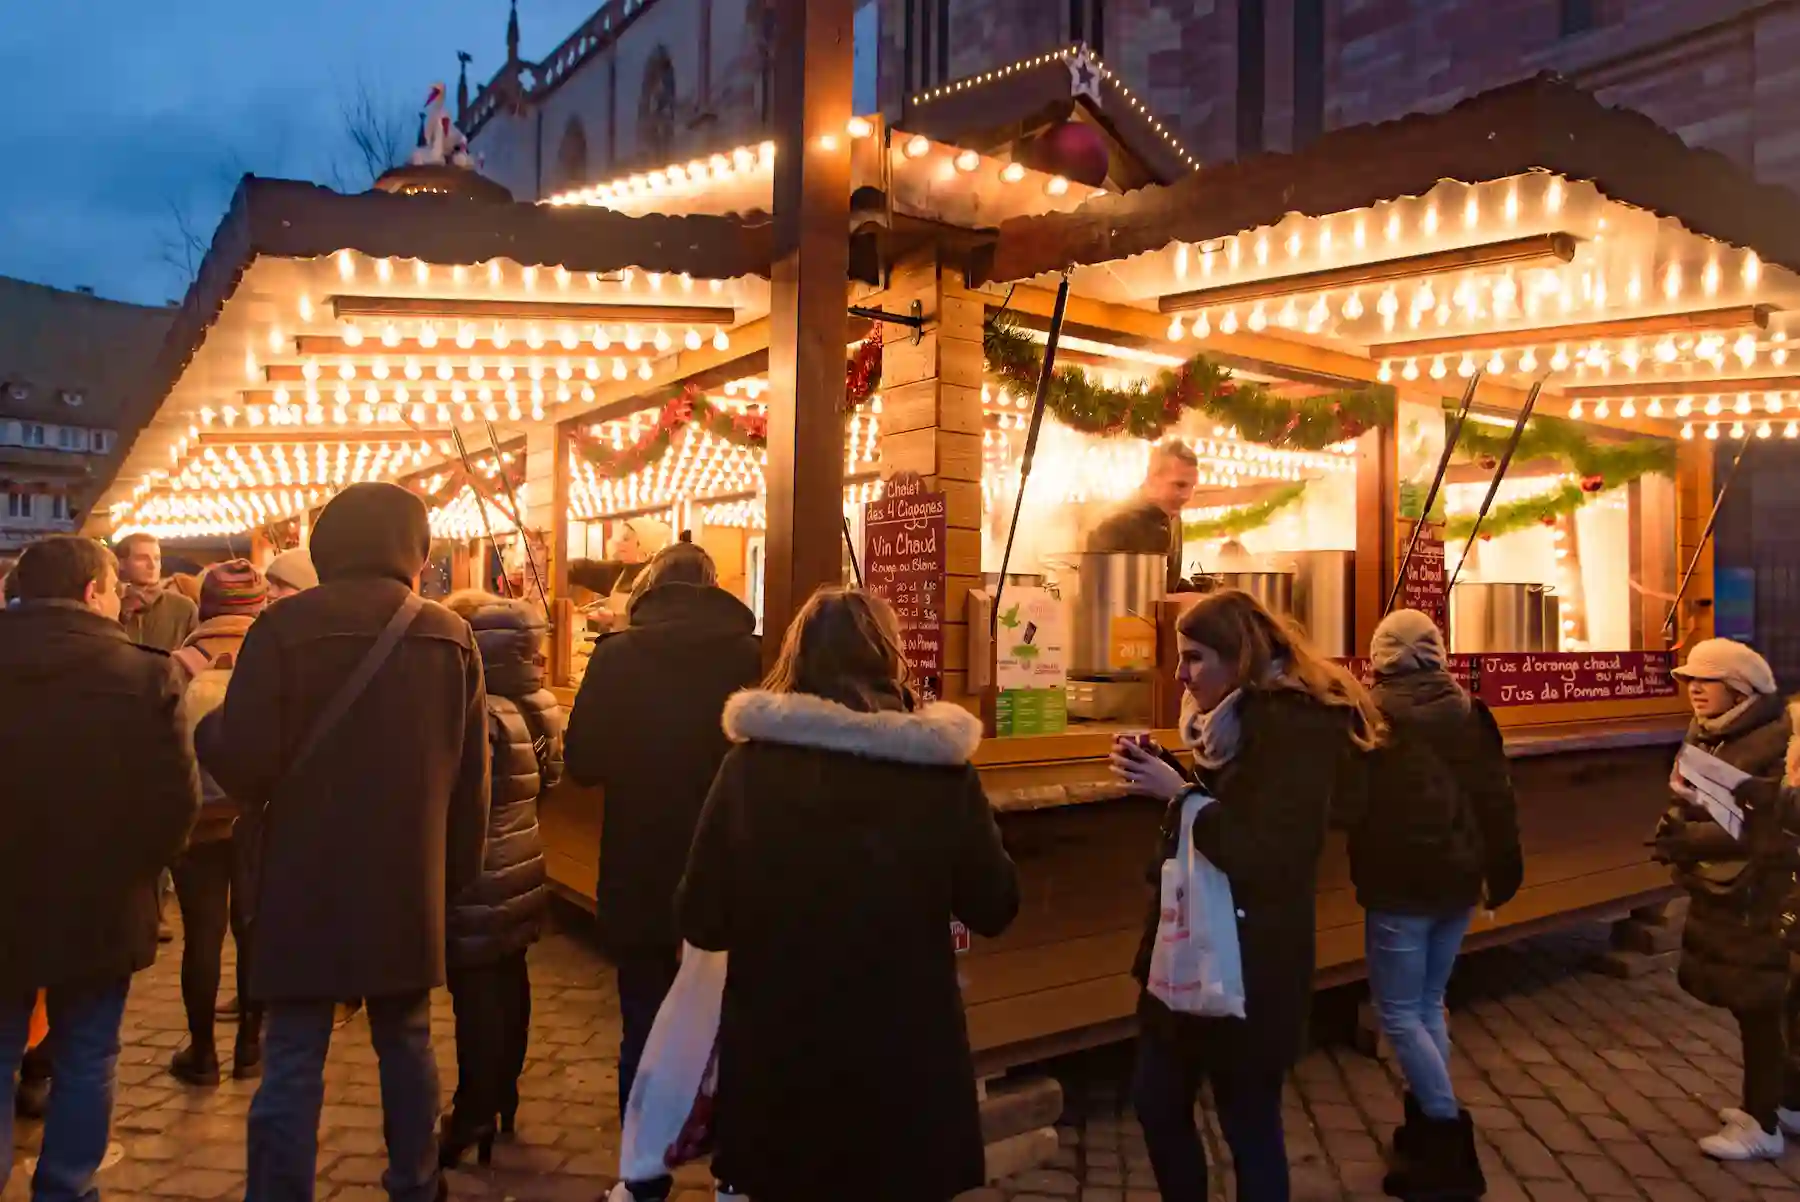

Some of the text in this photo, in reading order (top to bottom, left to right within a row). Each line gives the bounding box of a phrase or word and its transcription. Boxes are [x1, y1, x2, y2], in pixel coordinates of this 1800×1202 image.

[887, 477, 920, 498] Chalet
[867, 499, 944, 531] des 4 Cigognes
[872, 527, 937, 557] Vin Chaud
[871, 557, 938, 583] Rouge ou Blanc
[896, 594, 909, 605] 25
[1486, 658, 1517, 673] Jus
[1522, 655, 1580, 681] d'orange
[1583, 654, 1620, 670] chaud
[1596, 672, 1611, 682] au
[1615, 665, 1637, 681] miel
[1501, 684, 1535, 701] Jus
[1540, 682, 1559, 700] de
[1563, 682, 1611, 699] Pomme
[1615, 678, 1644, 695] chaud
